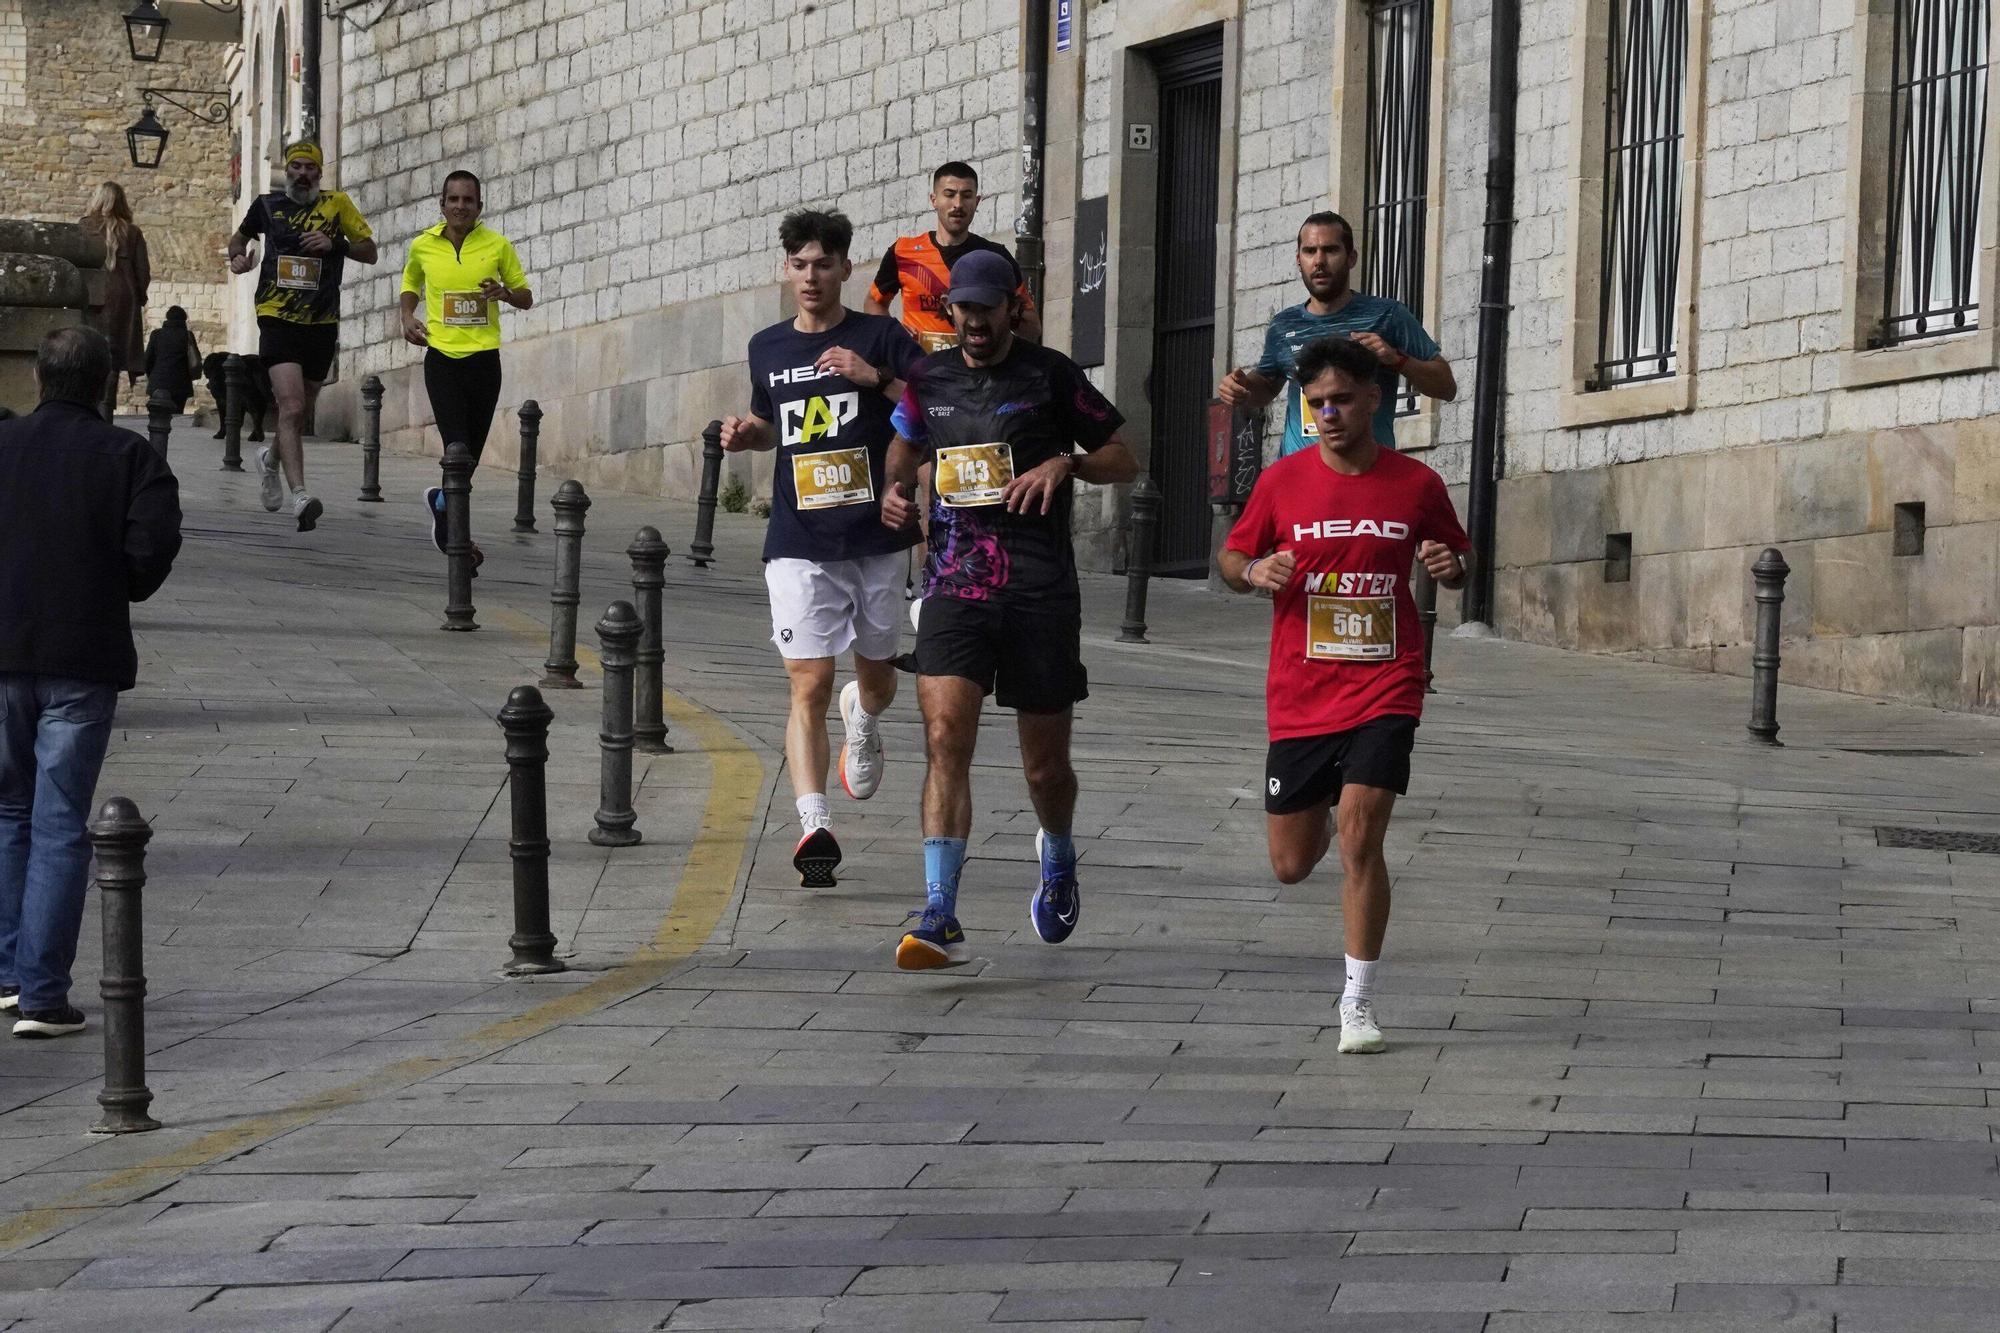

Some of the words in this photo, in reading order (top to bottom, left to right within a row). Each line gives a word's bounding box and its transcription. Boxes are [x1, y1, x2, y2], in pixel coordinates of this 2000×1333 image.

[1135, 127, 1147, 146] 3
[291, 264, 307, 277] 80
[454, 300, 478, 314] 503
[769, 365, 841, 388] HEA
[779, 391, 859, 447] CAP
[813, 463, 852, 488] 690
[955, 460, 990, 485] 143
[1293, 519, 1409, 542] HEAD
[1304, 571, 1397, 595] MASTER
[1333, 613, 1373, 637] 561
